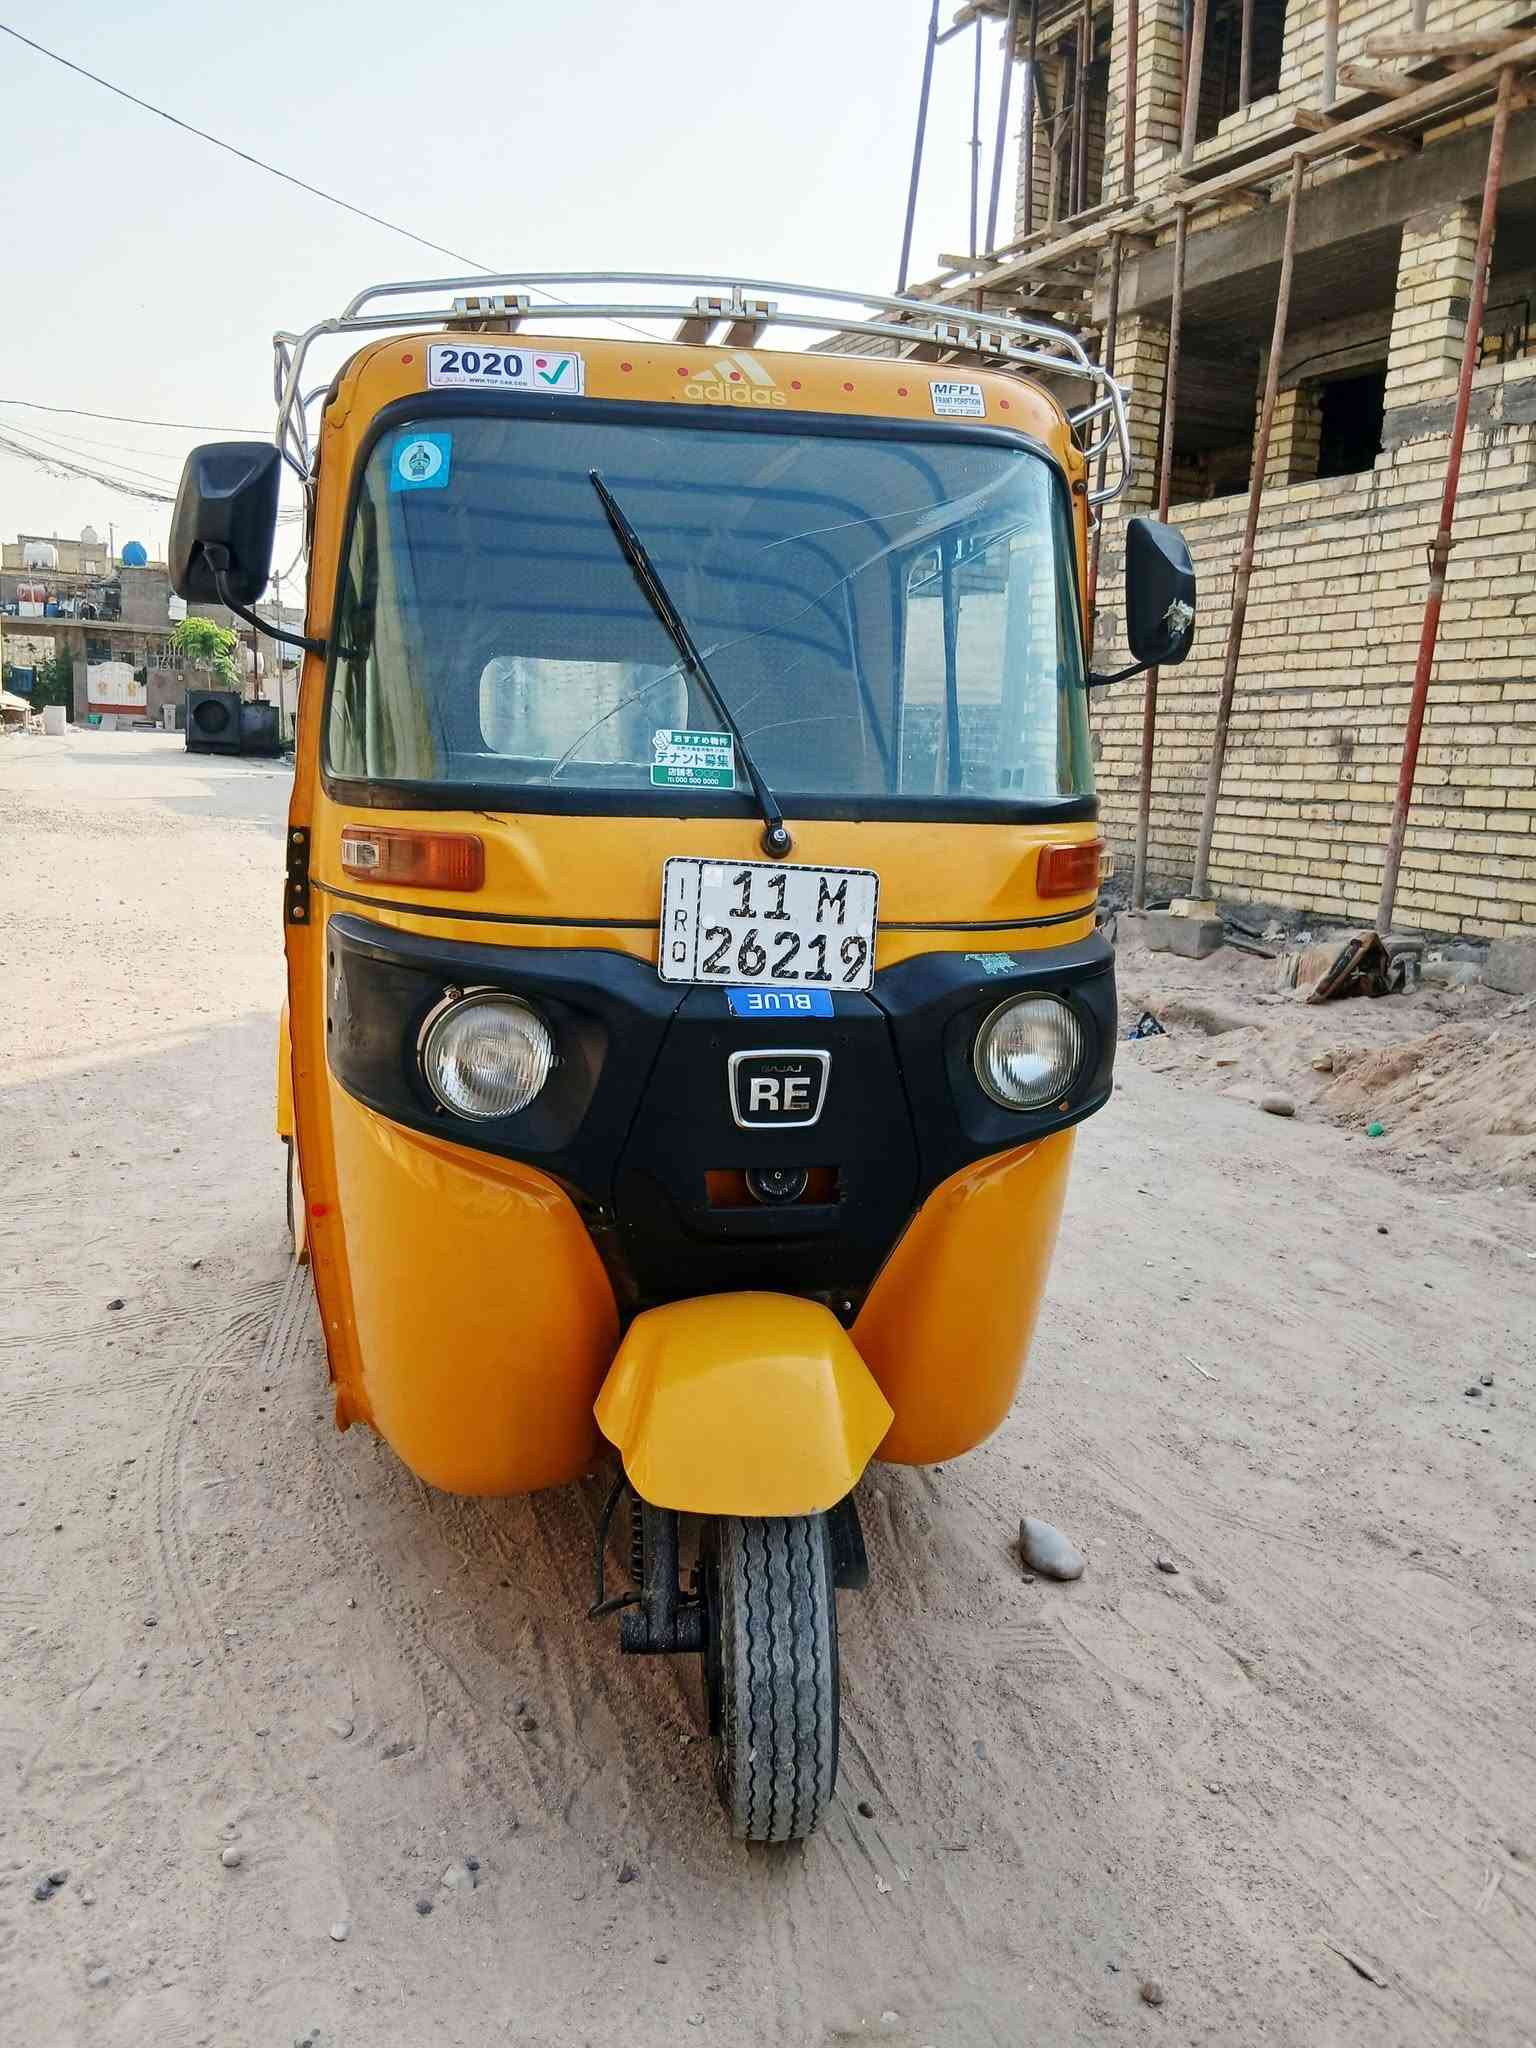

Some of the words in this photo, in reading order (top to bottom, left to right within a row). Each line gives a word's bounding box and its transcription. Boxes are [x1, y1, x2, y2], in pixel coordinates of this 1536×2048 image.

[439, 349, 523, 377] 2020
[684, 383, 786, 405] adidas
[934, 384, 980, 396] MFPL
[656, 752, 729, 767] テナント募集
[729, 870, 792, 921] 11
[815, 876, 848, 925] M
[702, 925, 868, 983] 26219
[747, 993, 812, 1010] BLUE
[749, 1077, 811, 1111] RE
